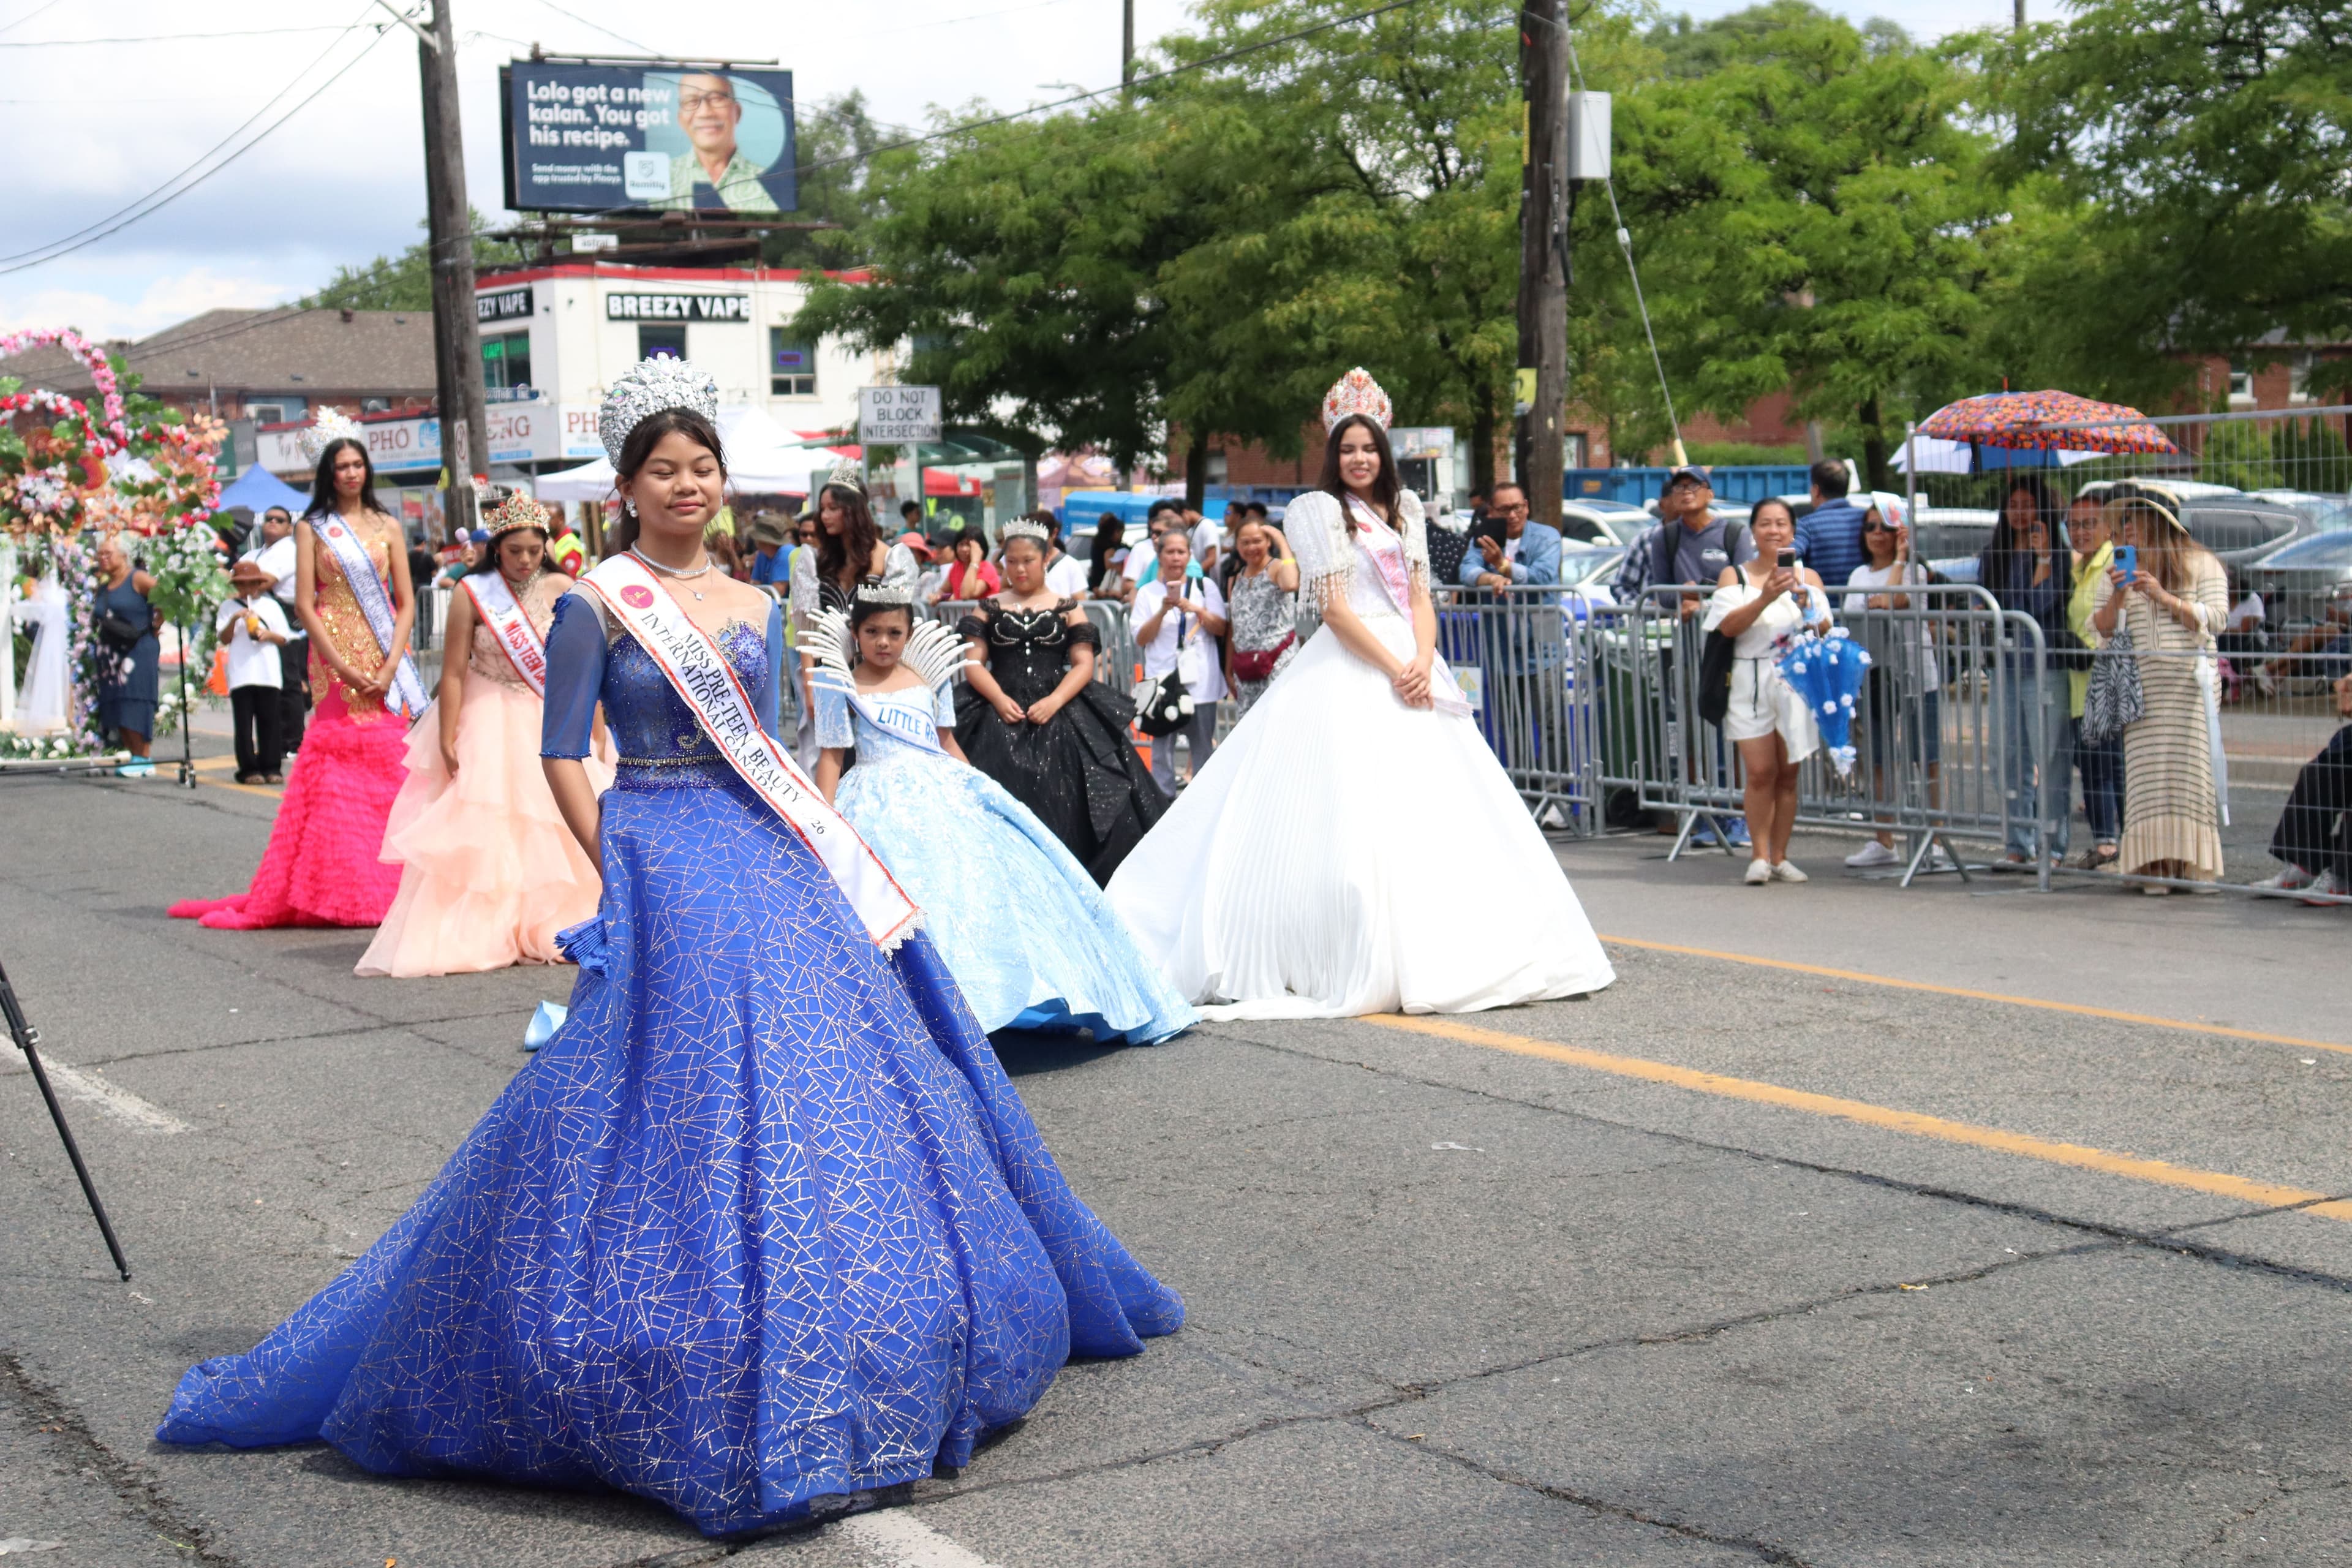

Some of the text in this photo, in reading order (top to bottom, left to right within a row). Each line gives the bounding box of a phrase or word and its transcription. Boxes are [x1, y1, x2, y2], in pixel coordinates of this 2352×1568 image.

[527, 80, 671, 106] Lolo got a new
[528, 102, 670, 131] kalan. You got
[529, 124, 631, 151] his recipe.
[532, 162, 552, 172] Send
[584, 164, 603, 173] with
[498, 292, 526, 314] VAPE
[608, 295, 751, 318] BREEZY VAPE
[873, 391, 926, 404] DO NOT
[876, 407, 924, 421] BLOCK
[862, 424, 938, 438] INTERSECTION
[503, 619, 529, 650] MISS
[518, 645, 545, 673] TEEN
[641, 612, 726, 734] INTERNATIONAL
[679, 633, 714, 669] MISS
[705, 666, 753, 747] PRE-TEEN
[748, 747, 804, 804] BEAUTY
[876, 706, 922, 736] LITTLE
